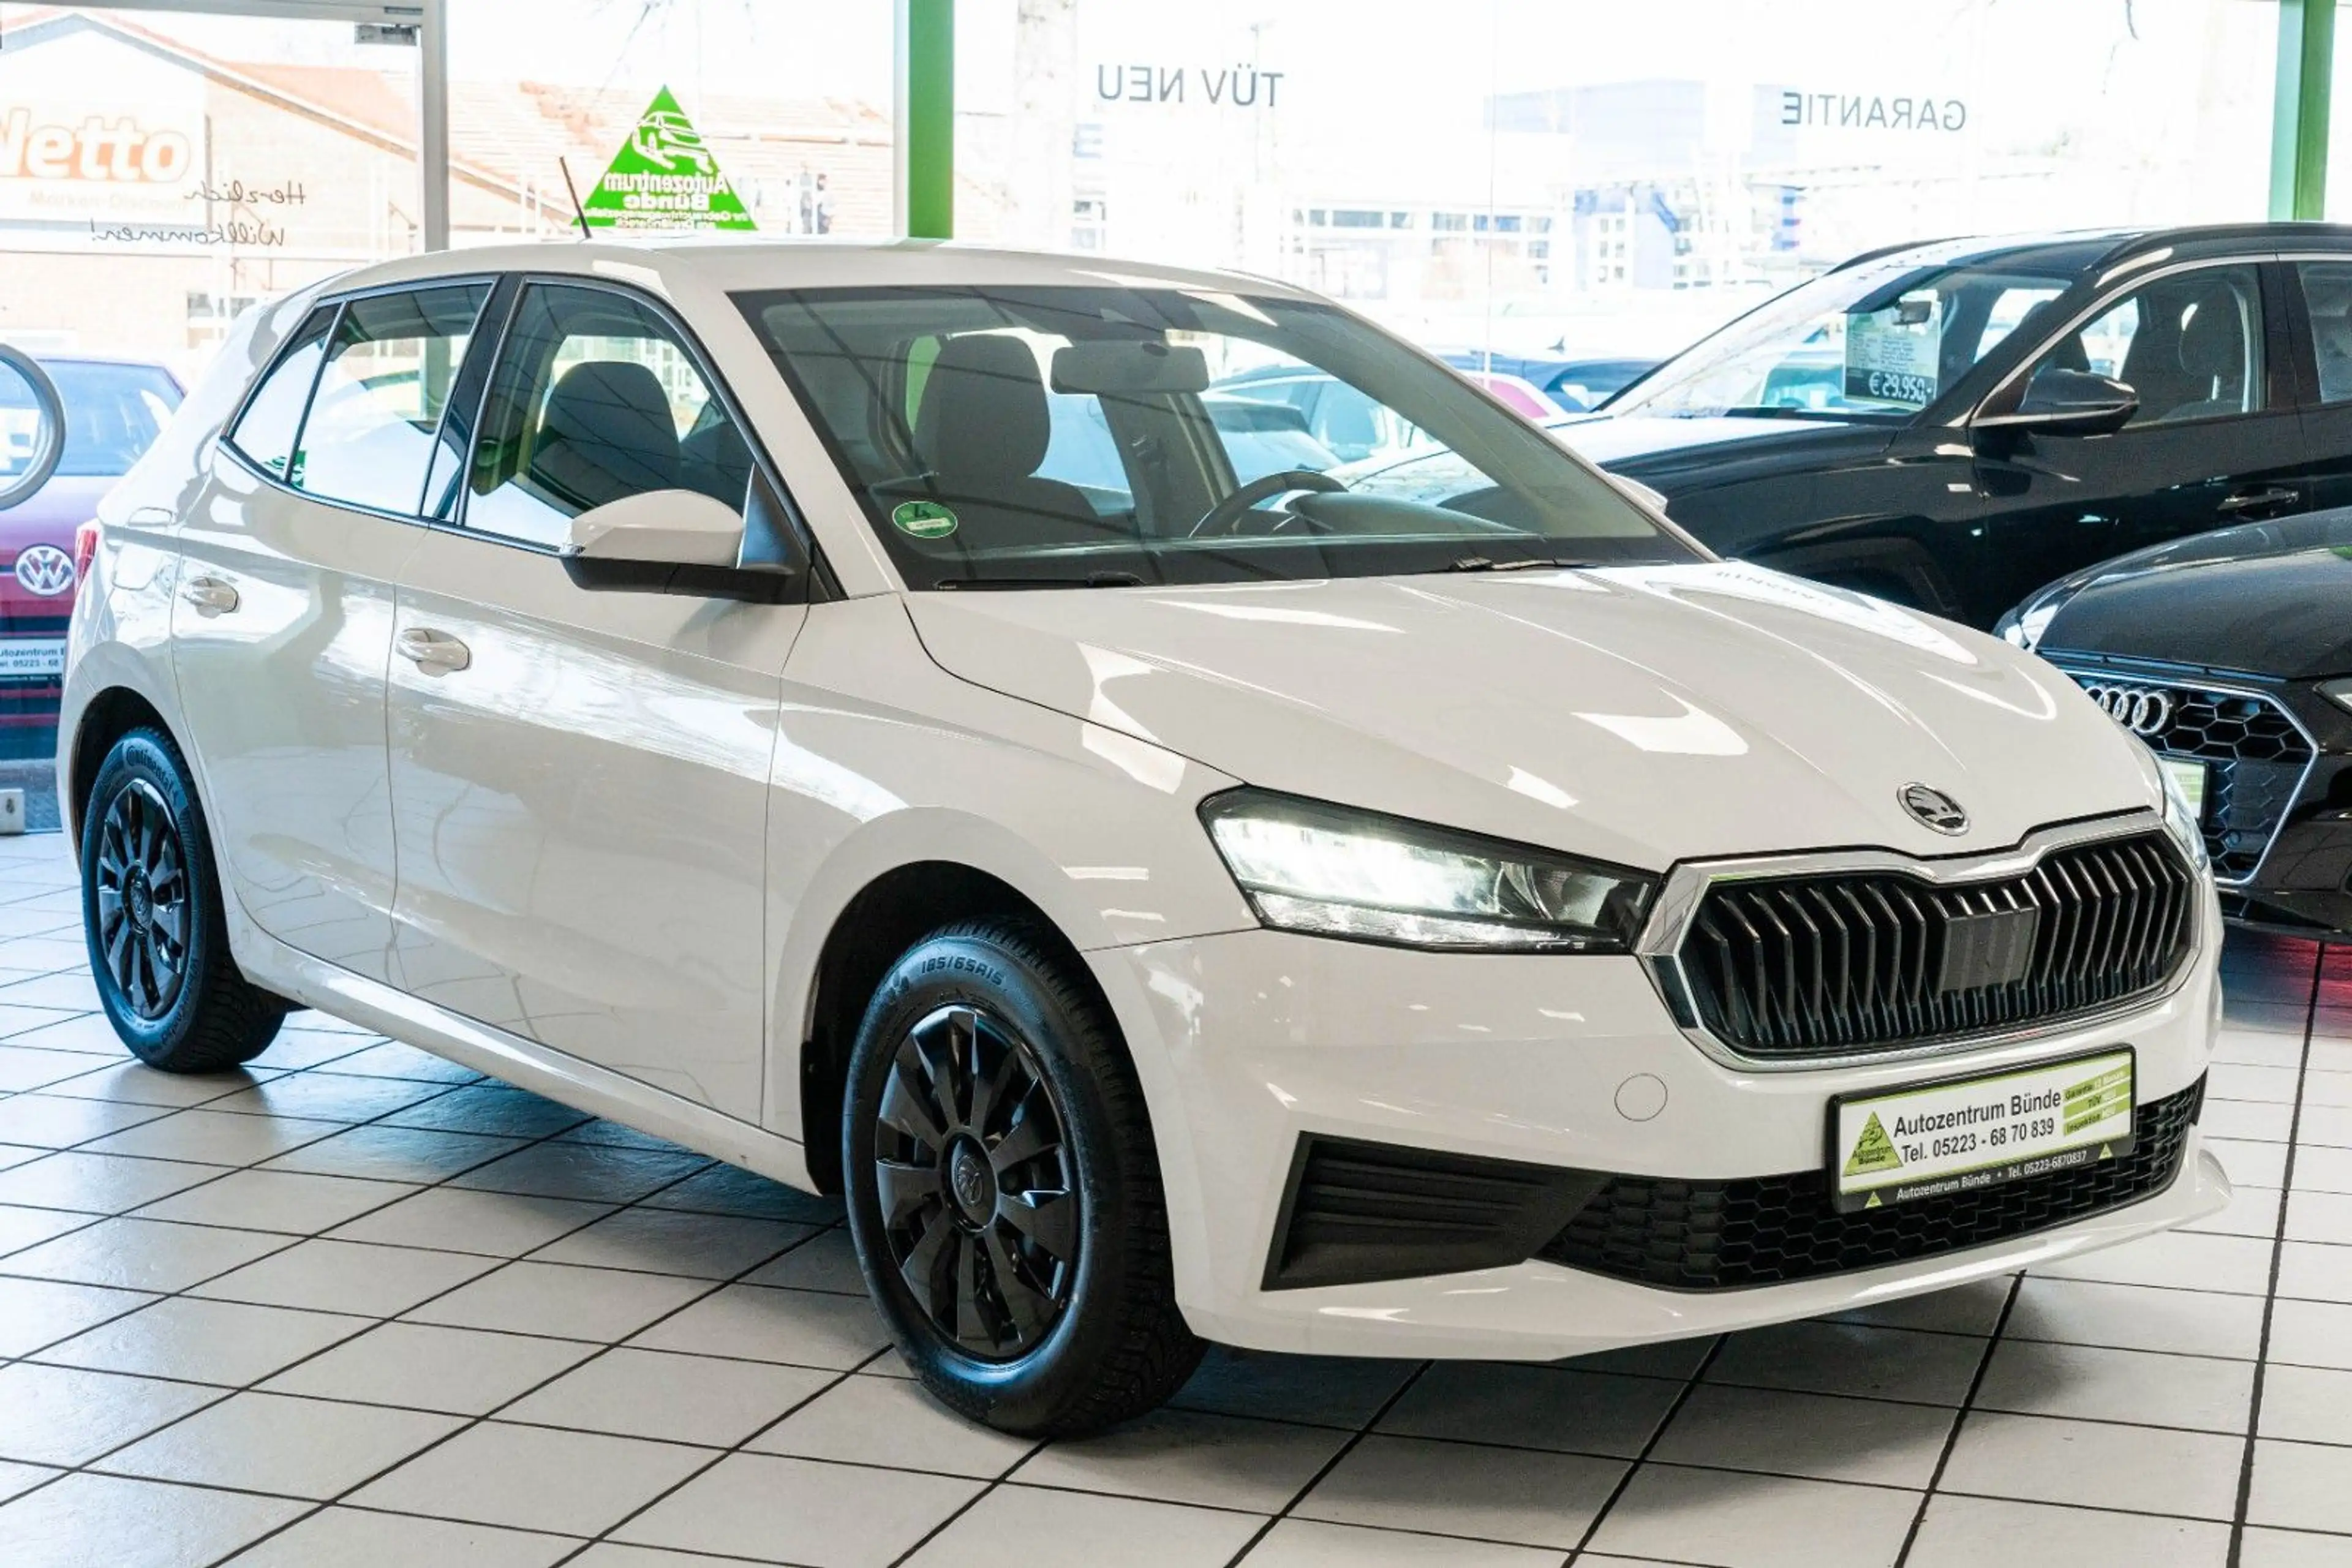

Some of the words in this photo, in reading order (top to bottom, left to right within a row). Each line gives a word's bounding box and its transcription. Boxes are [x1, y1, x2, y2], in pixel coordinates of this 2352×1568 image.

[921, 956, 1005, 986] 185/65R15
[1893, 1102, 2005, 1138] Autozentrum
[2011, 1089, 2061, 1117] Bünde
[1901, 1142, 1928, 1163] Tel.
[1932, 1133, 1977, 1158] 05223
[1990, 1127, 2007, 1147] 68
[2011, 1122, 2027, 1143] 70
[2031, 1117, 2054, 1139] 839
[1896, 1178, 1959, 1201] Autozentrum
[1961, 1171, 1991, 1188] Bünde
[2008, 1166, 2022, 1178] Tel.
